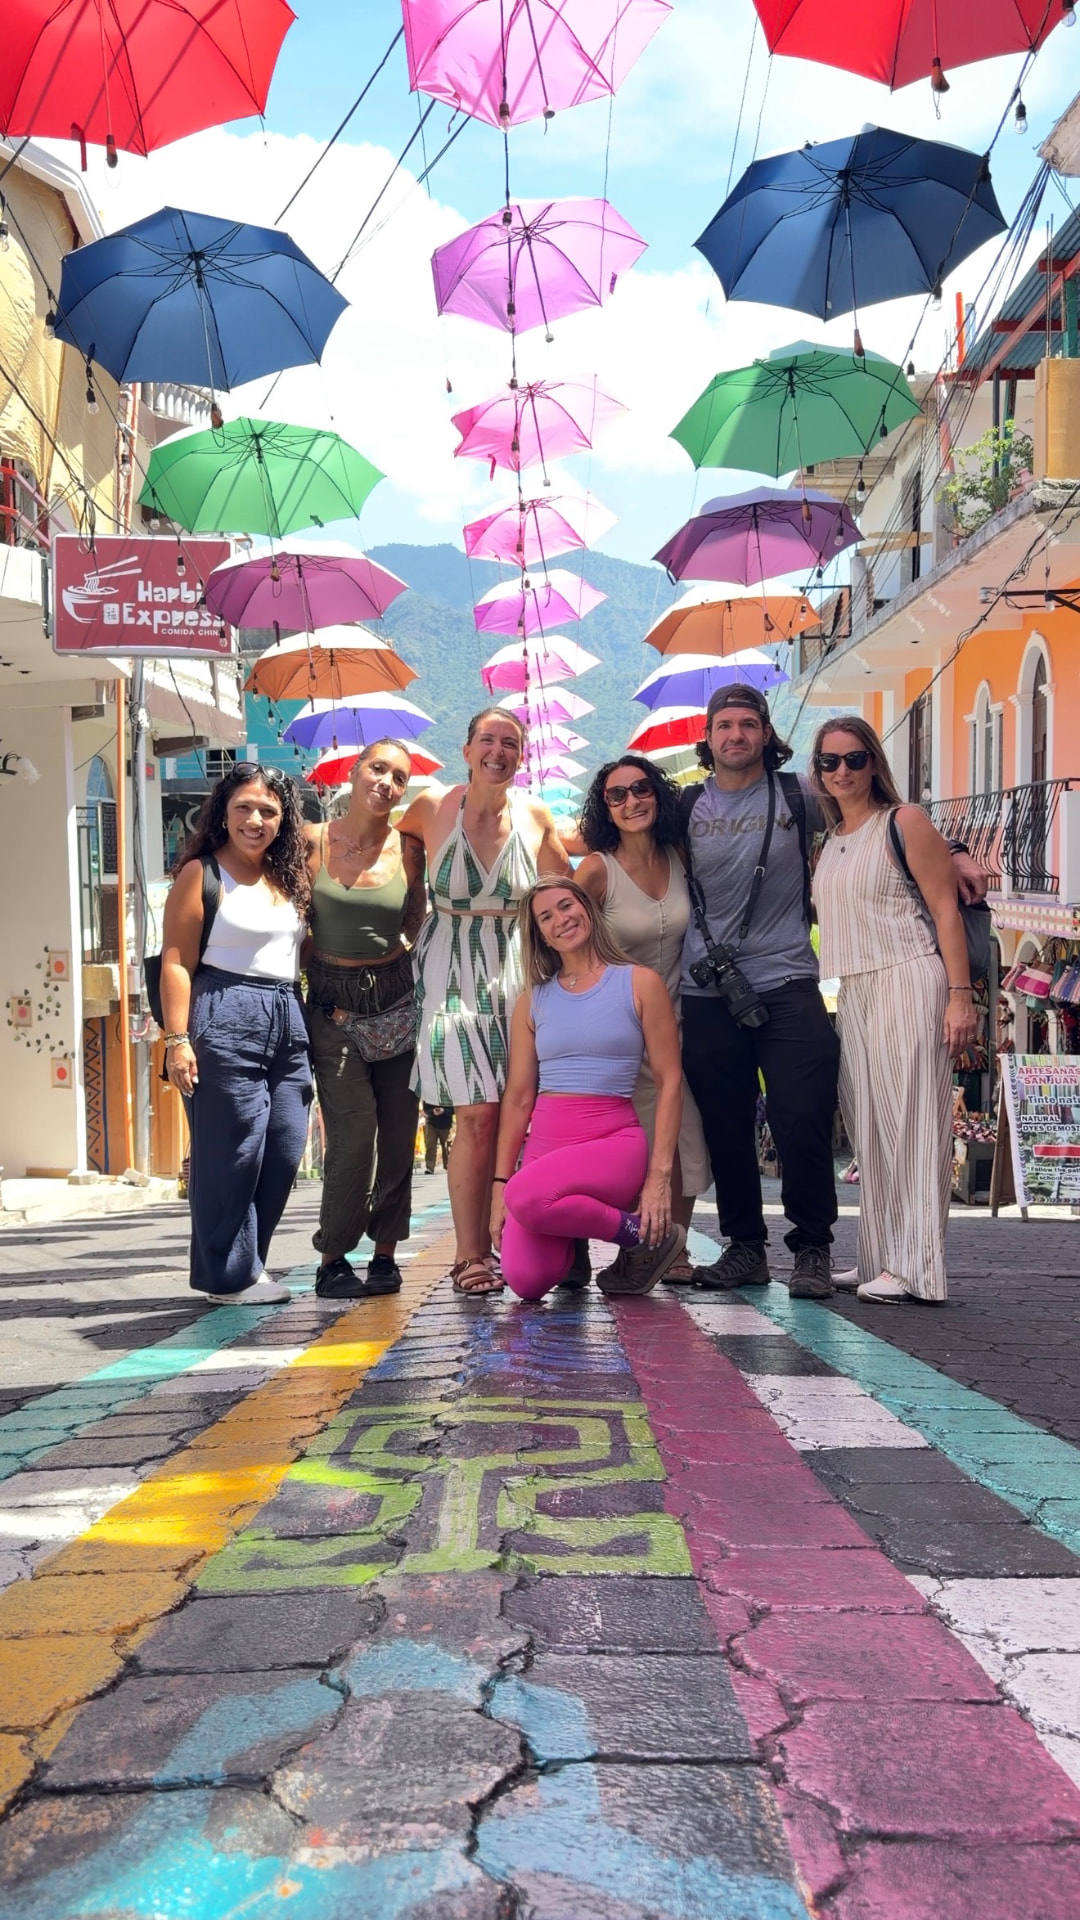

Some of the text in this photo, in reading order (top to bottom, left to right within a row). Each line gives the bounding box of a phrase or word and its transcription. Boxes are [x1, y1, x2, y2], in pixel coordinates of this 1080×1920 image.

[138, 580, 205, 603] Harbi
[1024, 1077, 1046, 1085] SAN
[1049, 1077, 1077, 1085] JUAN
